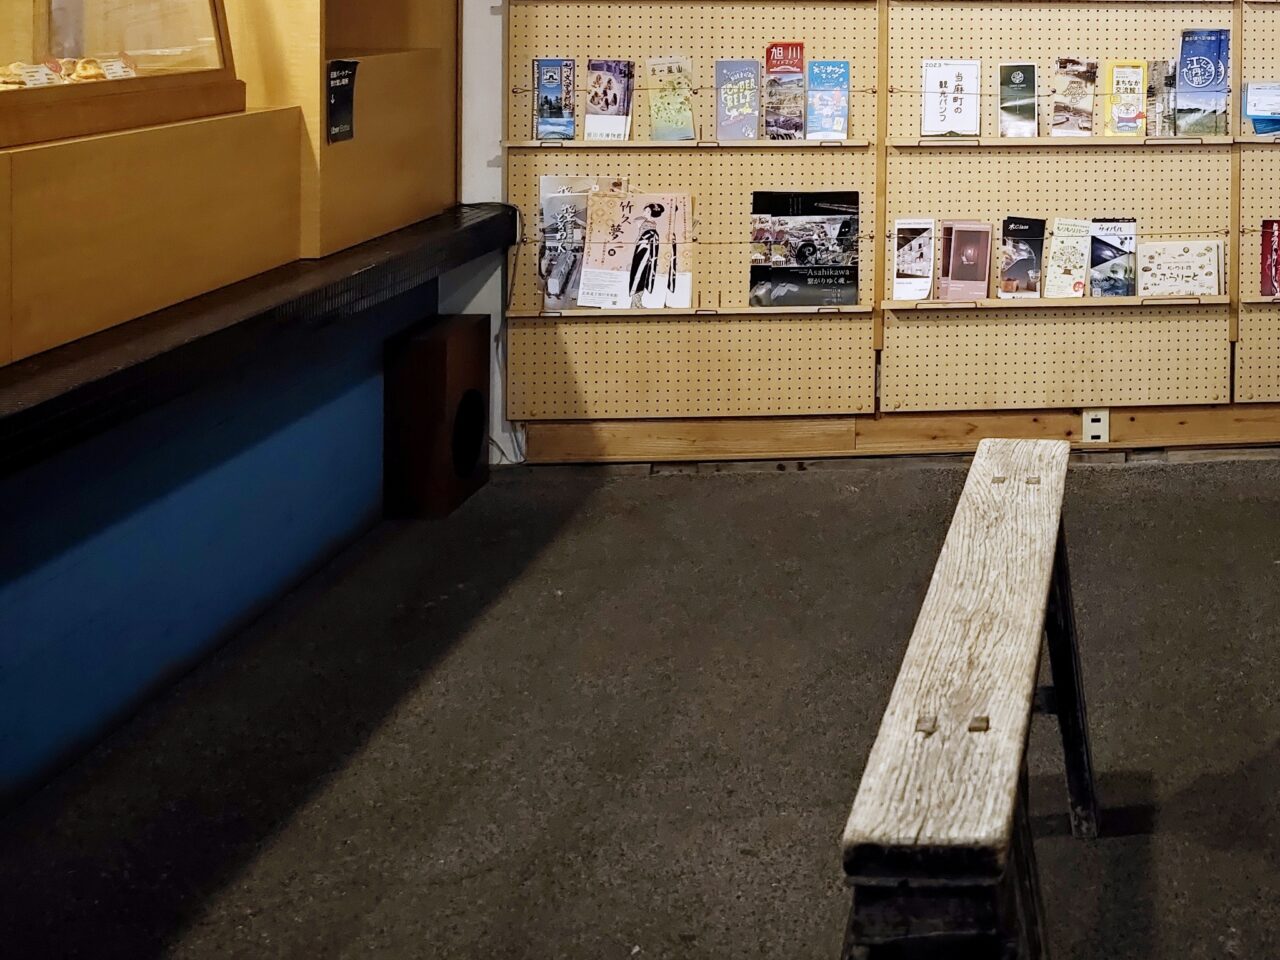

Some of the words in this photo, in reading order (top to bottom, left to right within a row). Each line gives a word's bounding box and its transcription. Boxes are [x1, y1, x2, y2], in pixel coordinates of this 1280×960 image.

[770, 46, 801, 60] 旭川
[952, 71, 965, 114] 当麻町の
[1115, 79, 1141, 87] まちなか
[938, 80, 949, 123] 観光パンフ
[608, 200, 635, 249] 竹久夢二
[806, 268, 850, 276] Asahikawa
